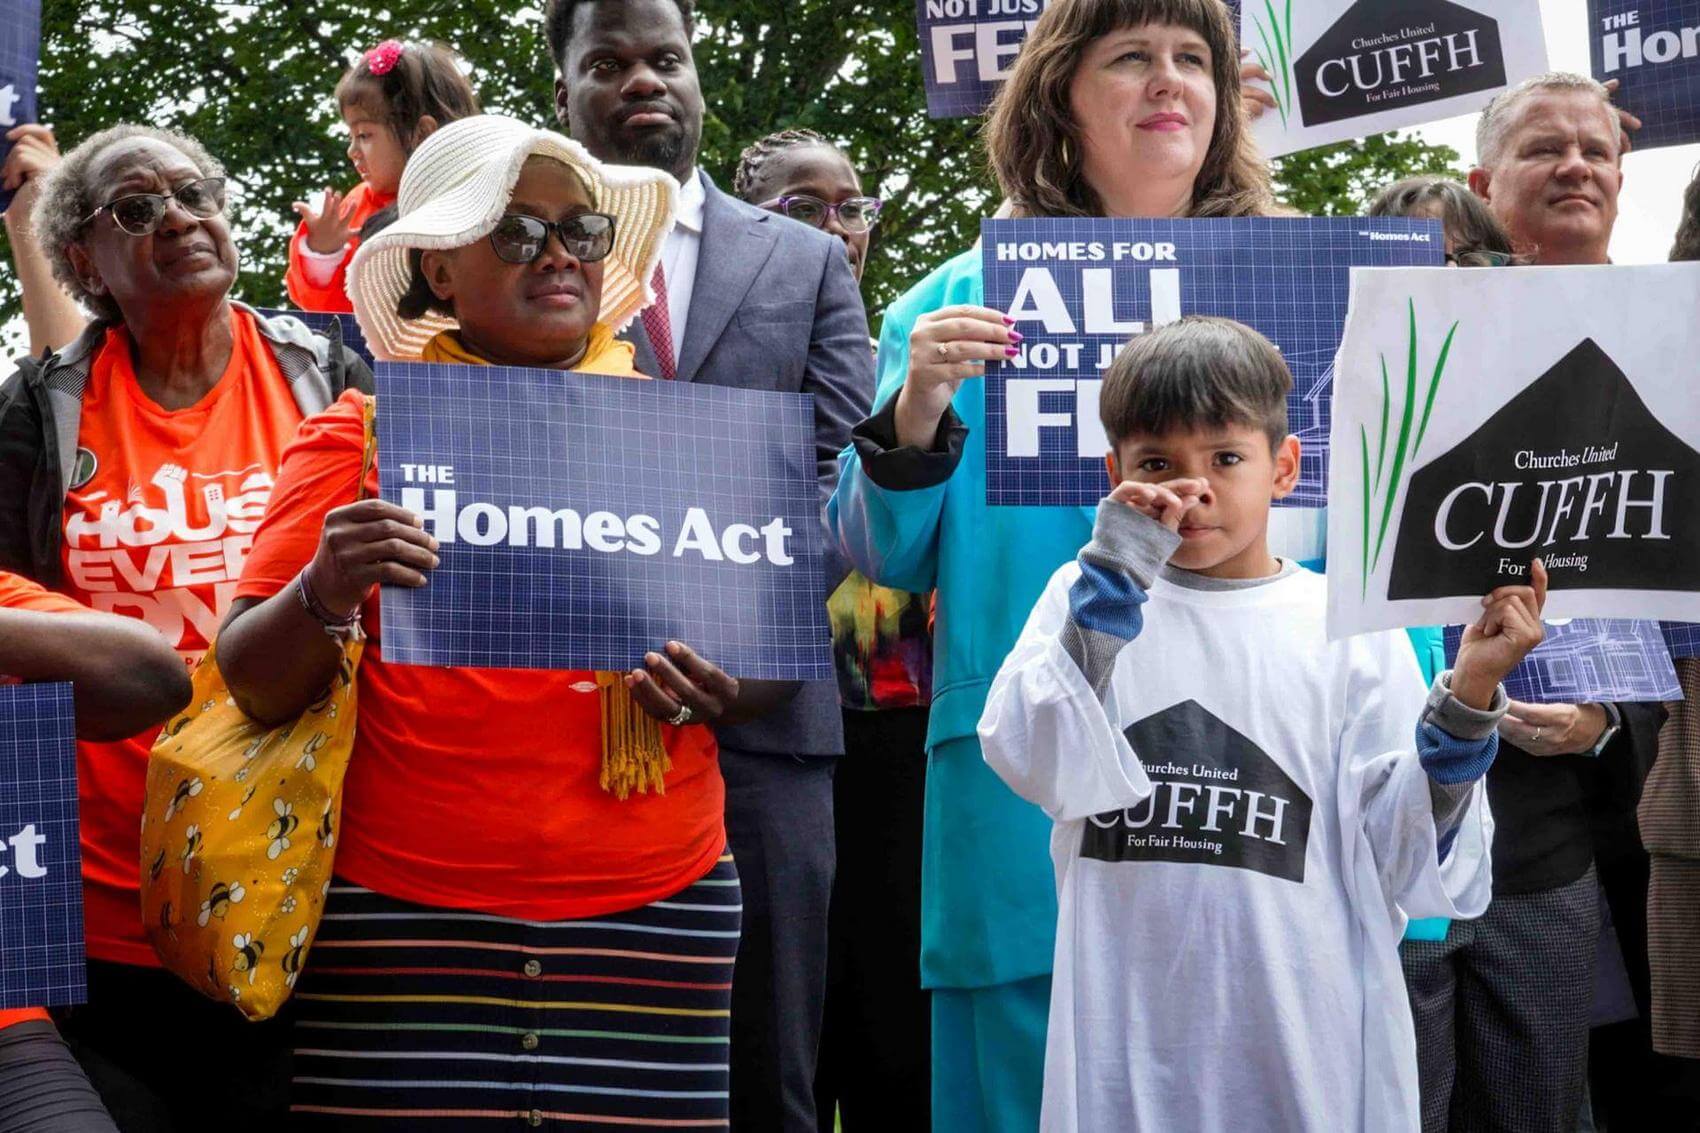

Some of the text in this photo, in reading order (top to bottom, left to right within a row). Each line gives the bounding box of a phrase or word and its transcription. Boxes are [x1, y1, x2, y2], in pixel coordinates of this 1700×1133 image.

[1602, 10, 1640, 31] THE
[1352, 22, 1435, 50] Churches United
[931, 20, 1042, 84] FE
[1315, 29, 1485, 97] CUFFH
[1366, 82, 1440, 103] For Fair Housing
[1369, 232, 1409, 241] Homes
[1411, 232, 1430, 242] Act
[997, 242, 1177, 261] HOMES FOR
[1001, 343, 1084, 369] NOT
[1514, 441, 1618, 469] Churches United
[400, 463, 455, 484] THE
[1434, 469, 1675, 551] CUFFH
[401, 487, 794, 567] Homes Act
[1497, 552, 1588, 576] For Housing
[1140, 760, 1238, 781] hurches United
[1088, 781, 1291, 846] UFFH
[1127, 834, 1223, 855] For Fair Housing
